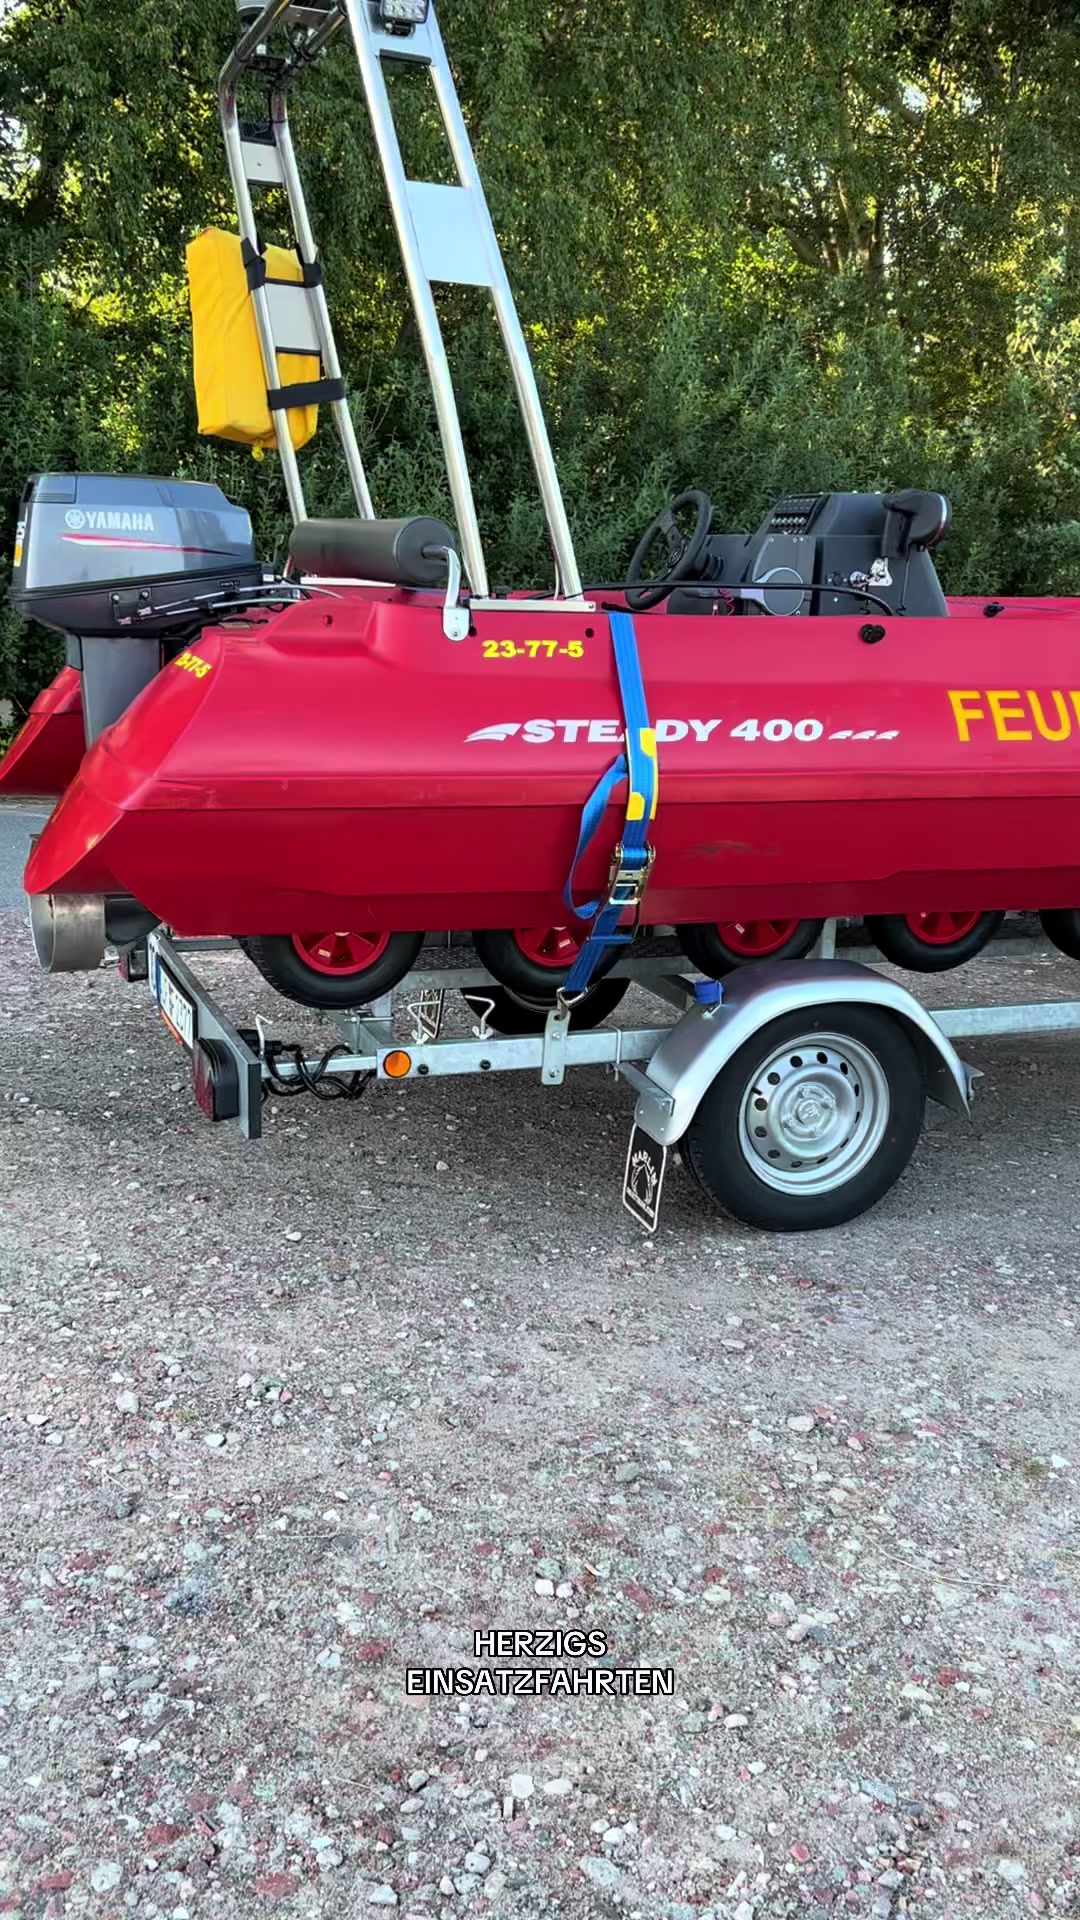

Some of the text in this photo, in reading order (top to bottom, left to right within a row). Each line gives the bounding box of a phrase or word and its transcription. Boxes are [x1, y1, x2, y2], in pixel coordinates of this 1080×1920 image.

[85, 511, 154, 531] YAMAHA
[482, 640, 584, 658] 23-77-5
[521, 719, 823, 743] STEDY 400
